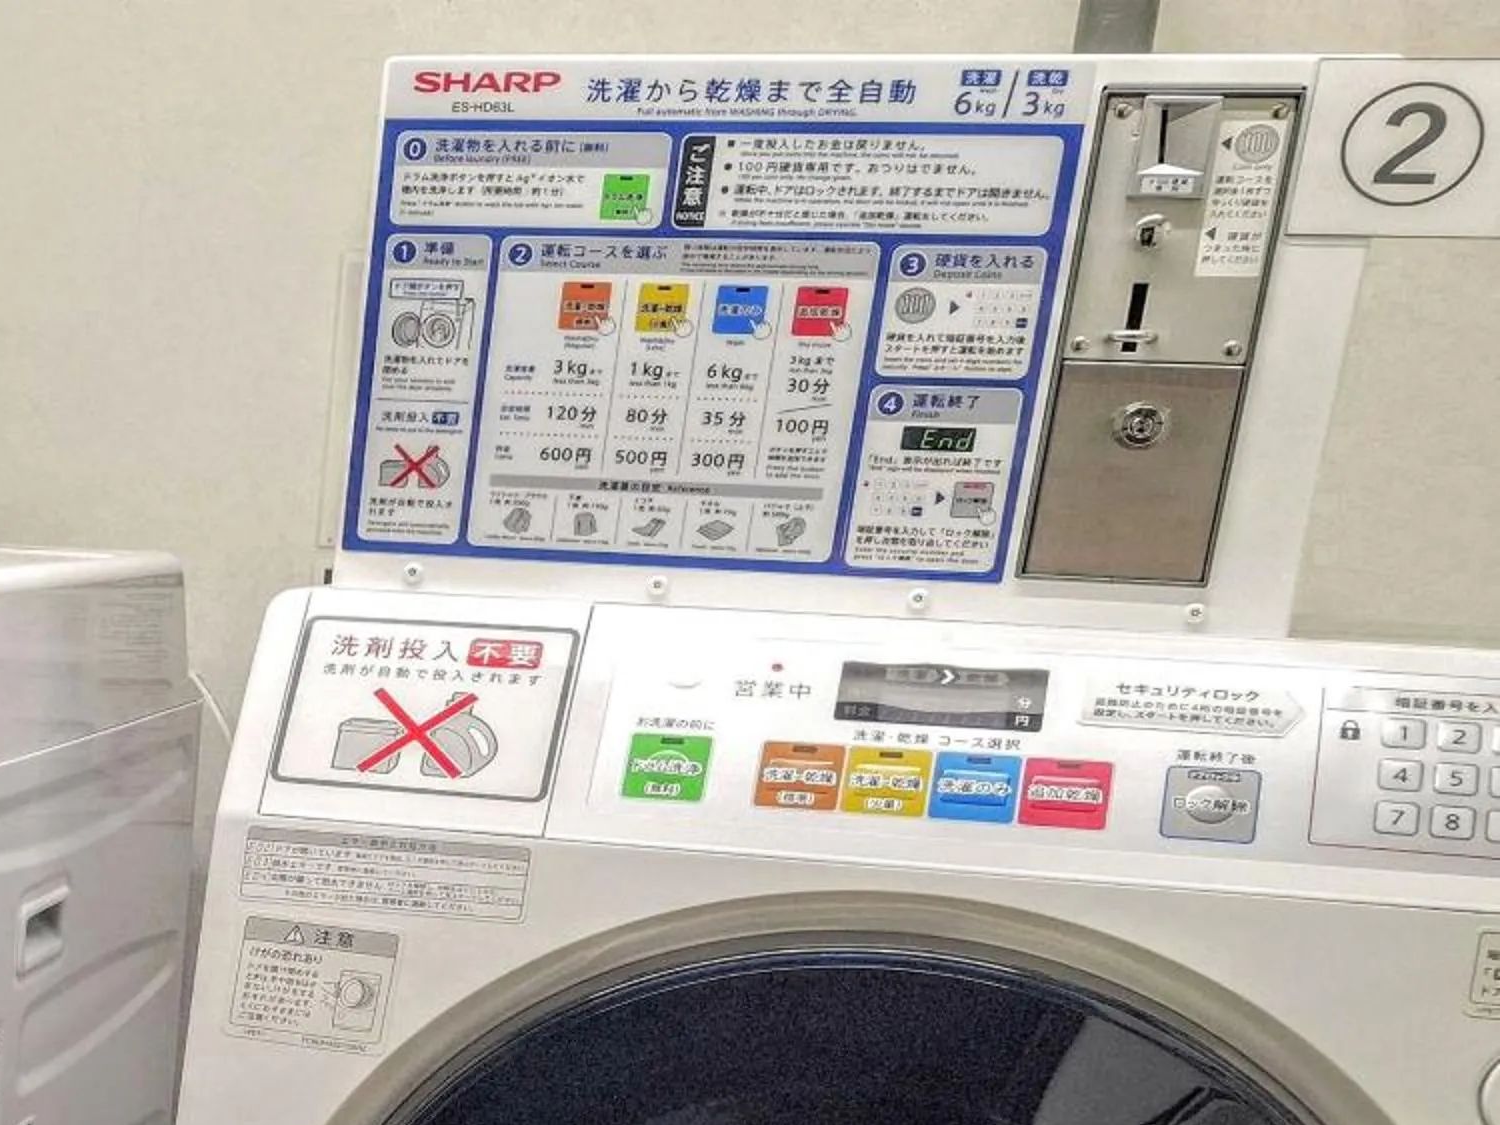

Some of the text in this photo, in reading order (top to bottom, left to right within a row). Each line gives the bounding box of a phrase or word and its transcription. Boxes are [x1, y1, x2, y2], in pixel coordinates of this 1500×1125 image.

[413, 71, 561, 93] SHARP
[586, 78, 917, 105] 洗濯から乾燥まで全自動
[451, 102, 515, 113] ES-HD63L
[435, 138, 577, 153] 洗濯物を入れる前に
[541, 243, 668, 260] 運転コースを選ぶ
[935, 253, 1035, 269] 硬貨を入れる
[787, 378, 831, 394] 30分
[911, 393, 980, 410] 運転終了
[547, 405, 597, 422] 120分
[625, 407, 668, 425] 80分
[702, 411, 746, 427] 35分
[775, 418, 830, 435] 100円
[919, 429, 974, 450] End
[539, 447, 592, 464] 600円
[615, 449, 668, 467] 500円
[691, 452, 745, 469] 300円
[330, 633, 540, 668] 洗剤投入 不要
[322, 663, 544, 687] 洗剤が自動で投入されます
[734, 680, 812, 700] 営業中
[1116, 683, 1260, 702] セキュリティロック
[635, 716, 716, 731] お洗濯の前に
[1015, 714, 1030, 728] 円
[1401, 725, 1408, 741] 1
[1452, 729, 1466, 745] 2
[938, 734, 1022, 750] コース選択
[1176, 749, 1257, 765] 運転終了後
[1392, 767, 1409, 783] 4
[1450, 770, 1464, 787] 5
[937, 778, 1011, 796] 洗濯のみ
[1391, 809, 1405, 825] 7
[1444, 813, 1460, 831] 8
[314, 928, 355, 948] 注意
